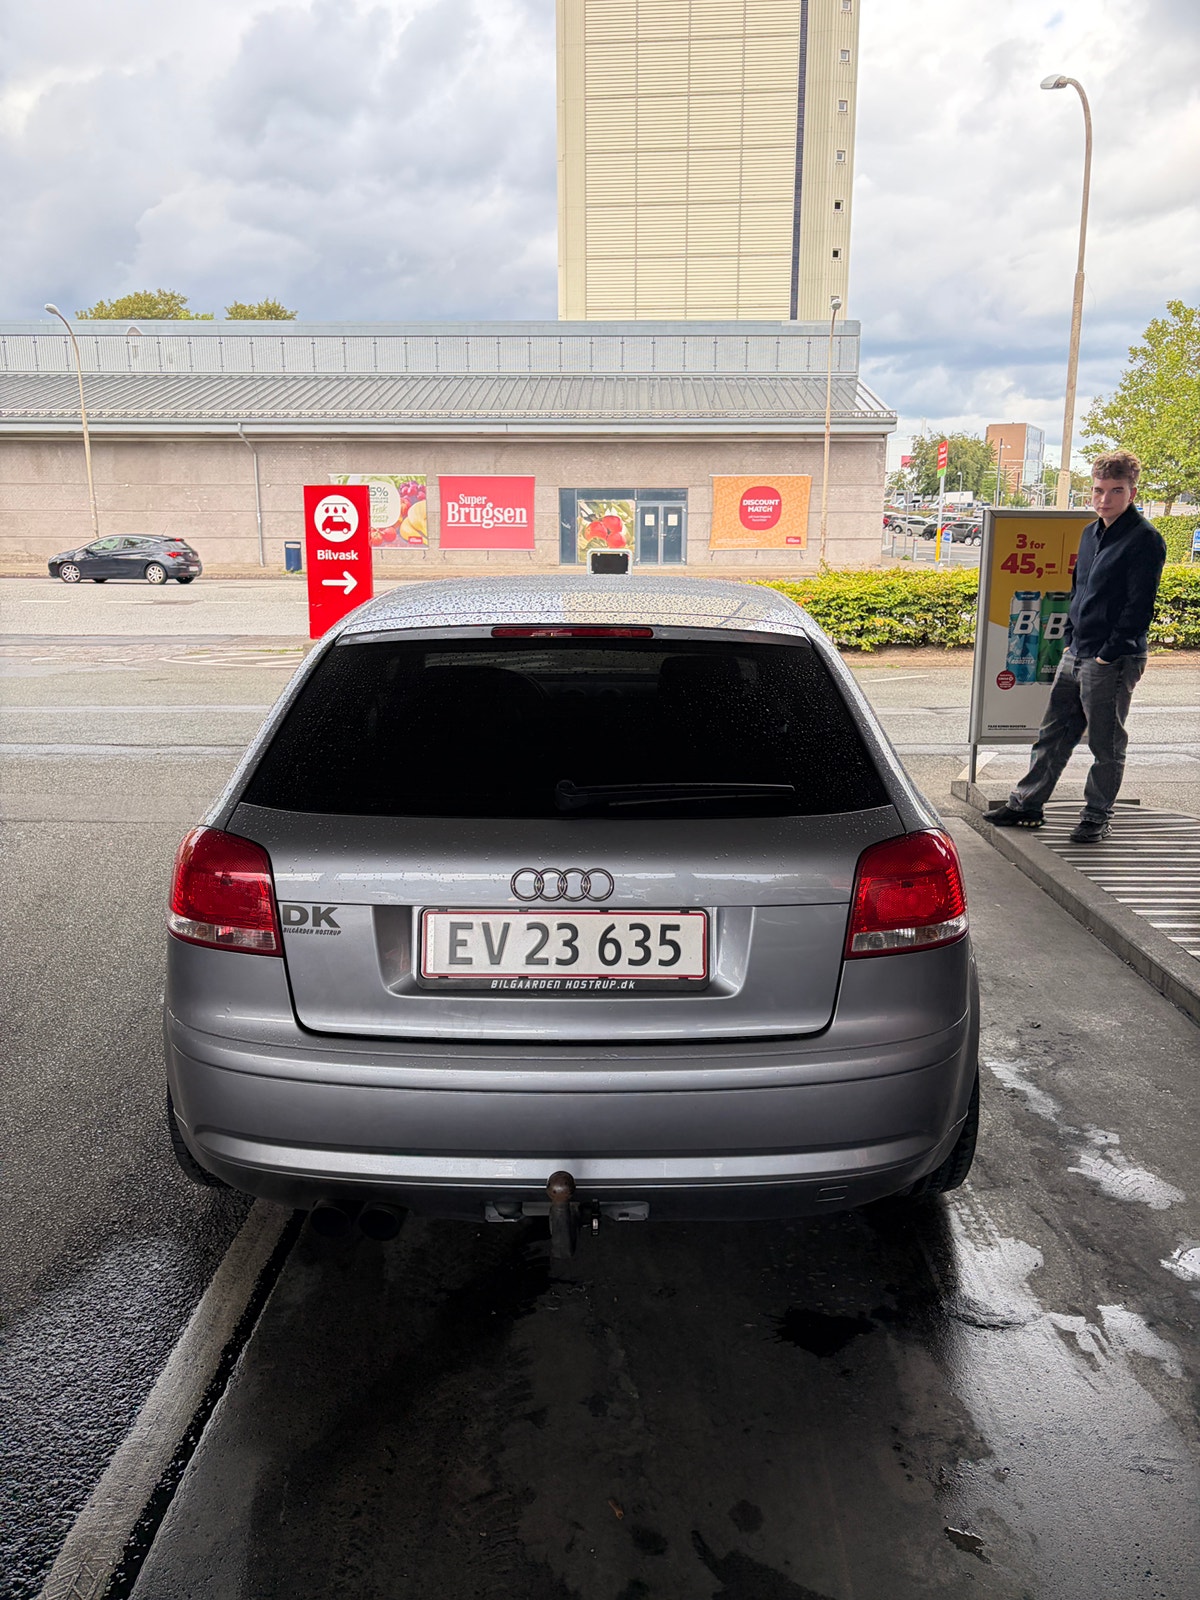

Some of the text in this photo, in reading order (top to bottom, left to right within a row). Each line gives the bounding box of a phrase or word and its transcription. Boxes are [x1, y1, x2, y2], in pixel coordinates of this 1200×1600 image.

[370, 487, 389, 497] 5%
[459, 494, 487, 507] Super
[446, 502, 528, 529] Brugsen
[1016, 533, 1046, 549] 3 for
[317, 549, 359, 561] Bilvask
[1001, 553, 1056, 579] 45,-
[1013, 610, 1037, 635] B
[1043, 612, 1068, 640] B
[282, 904, 341, 928] DK
[283, 927, 342, 936] BILGÅRDEN HOSTRUP
[449, 921, 682, 967] EV 23 635
[490, 980, 561, 989] BILGAARDEN
